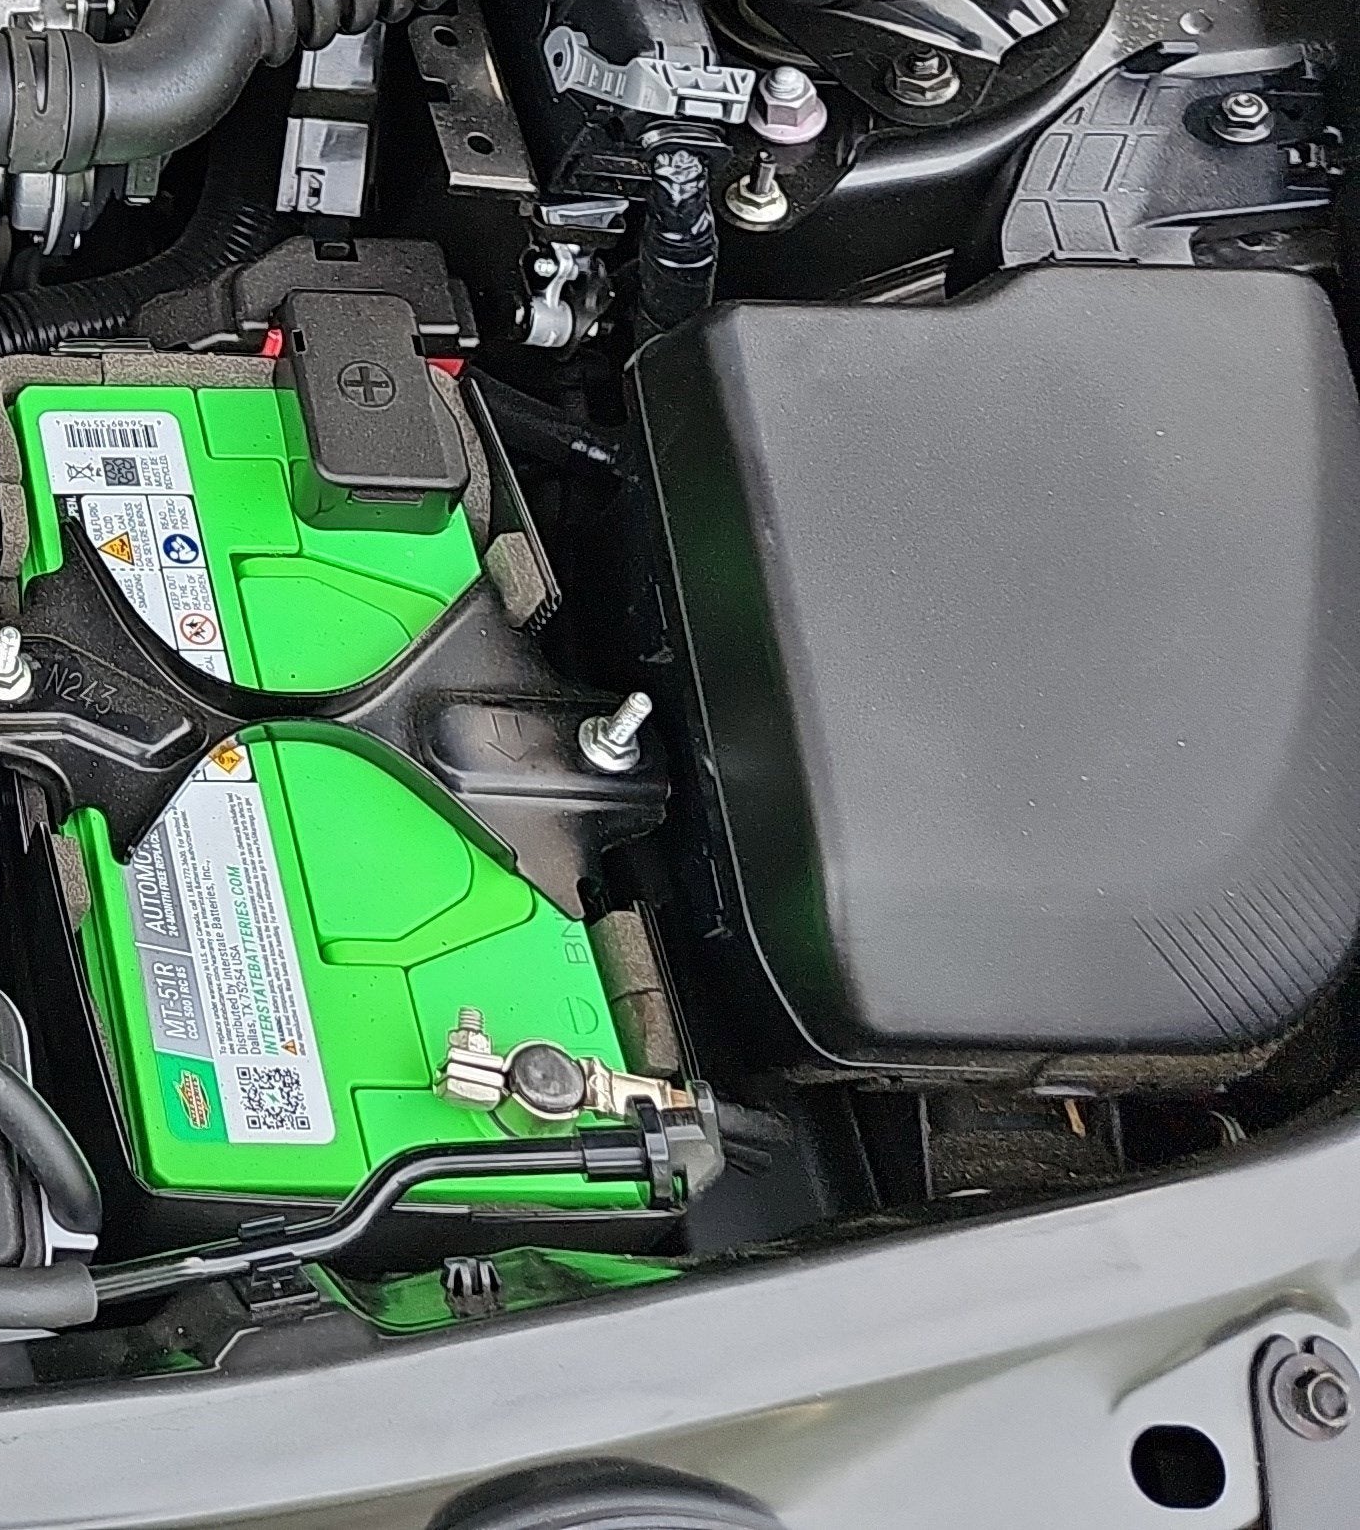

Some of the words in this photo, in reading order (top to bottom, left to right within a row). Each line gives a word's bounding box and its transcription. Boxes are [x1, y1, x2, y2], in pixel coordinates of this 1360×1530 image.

[139, 456, 152, 486] BATTERY
[87, 501, 104, 541] SULFURIC
[102, 515, 115, 534] ACID
[123, 502, 138, 541] BLINDNESS
[158, 510, 169, 529] READ
[131, 541, 144, 567] CAUSE
[138, 529, 151, 555] SEVERE
[165, 574, 177, 589] OUT
[177, 583, 189, 594] THE
[169, 590, 181, 610] KEEP
[188, 585, 202, 610] REACH
[43, 663, 118, 714] N243
[155, 869, 169, 890] FREE
[202, 882, 224, 929] Batteries,
[213, 931, 233, 980] Interstate
[225, 864, 279, 1055] INTERSTATEBATTERIES.COM
[228, 944, 243, 965] USA
[177, 979, 190, 993] RC
[222, 982, 239, 994] by
[233, 968, 250, 999] 75254
[151, 961, 188, 1039] MT-51R
[181, 999, 195, 1017] 500
[239, 1002, 254, 1017] TX
[185, 1019, 199, 1039] CCA
[226, 997, 249, 1054] Distributed
[243, 1019, 263, 1054] Dallas,
